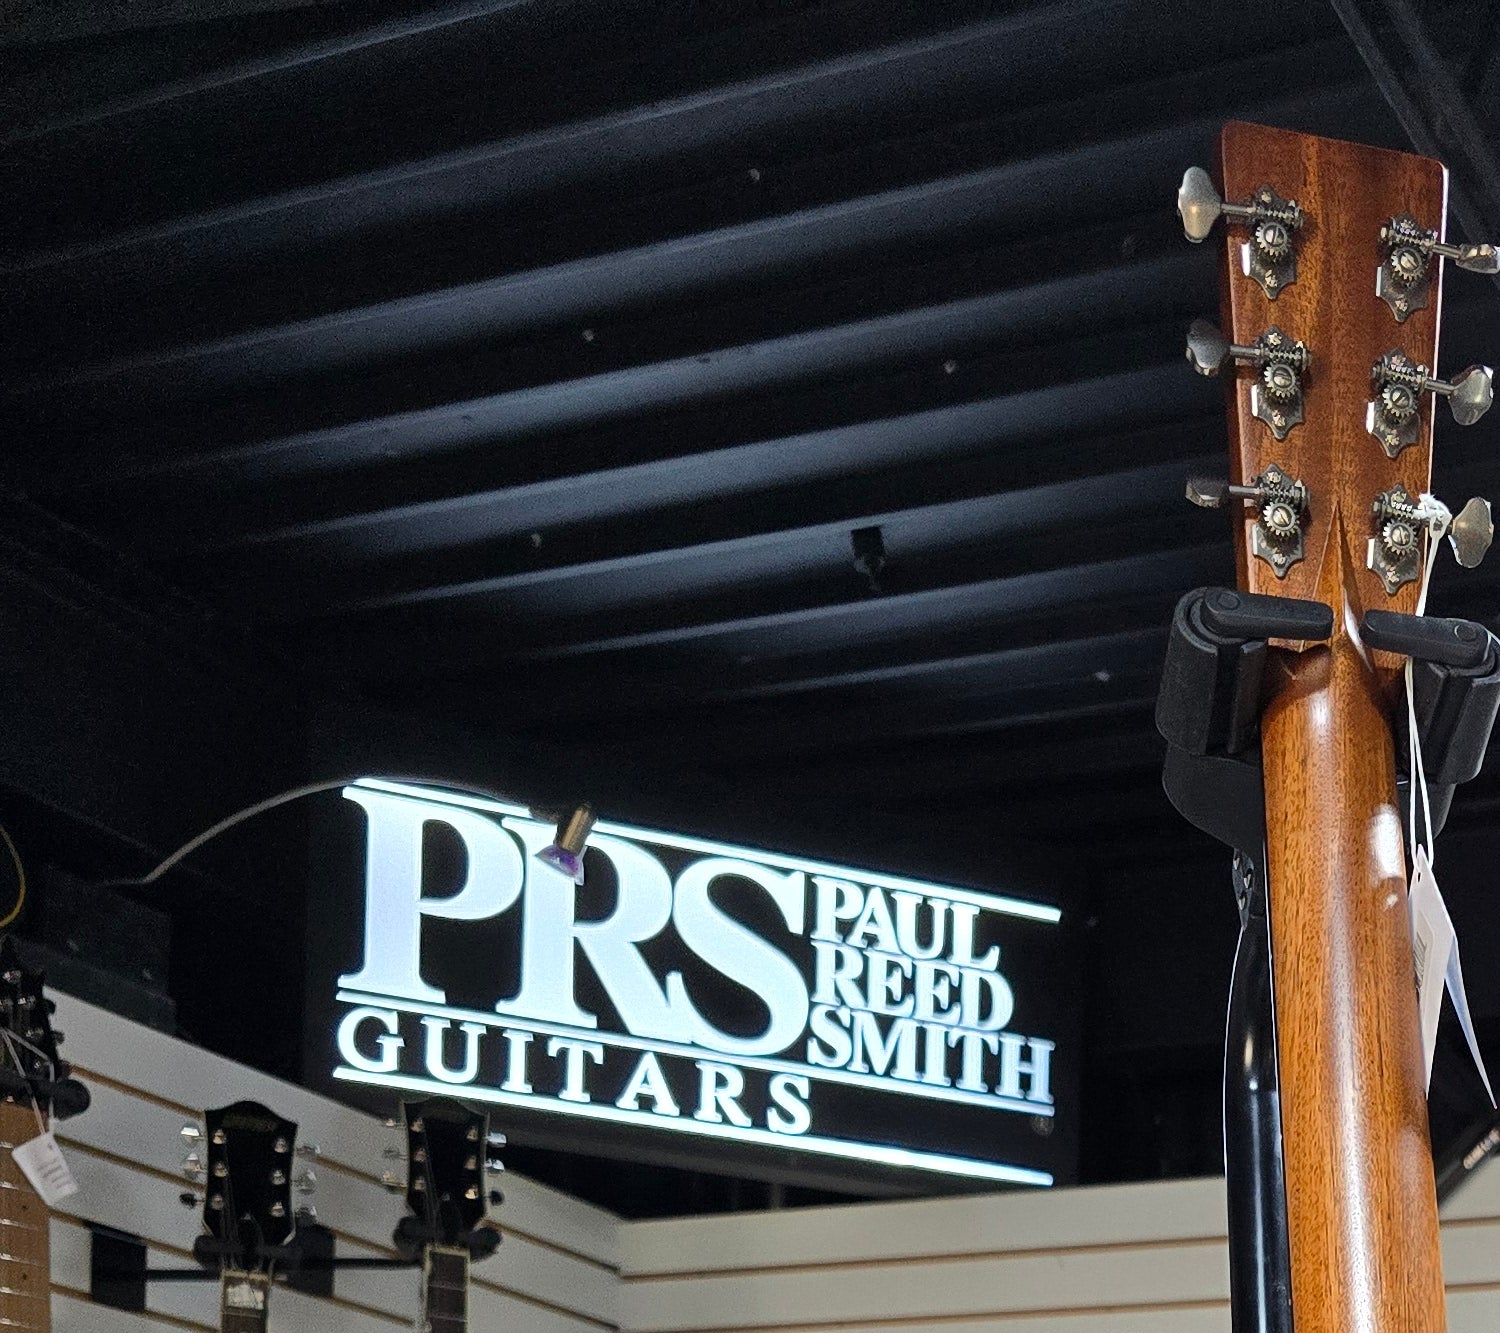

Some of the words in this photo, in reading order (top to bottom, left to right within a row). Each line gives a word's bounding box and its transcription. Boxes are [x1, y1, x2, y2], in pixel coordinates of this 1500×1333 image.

[338, 784, 807, 1058] PRS
[808, 874, 1000, 970] PAUL
[808, 938, 1015, 1033] REED
[336, 1006, 813, 1136] GUITARS
[807, 1001, 1056, 1102] SMITH
